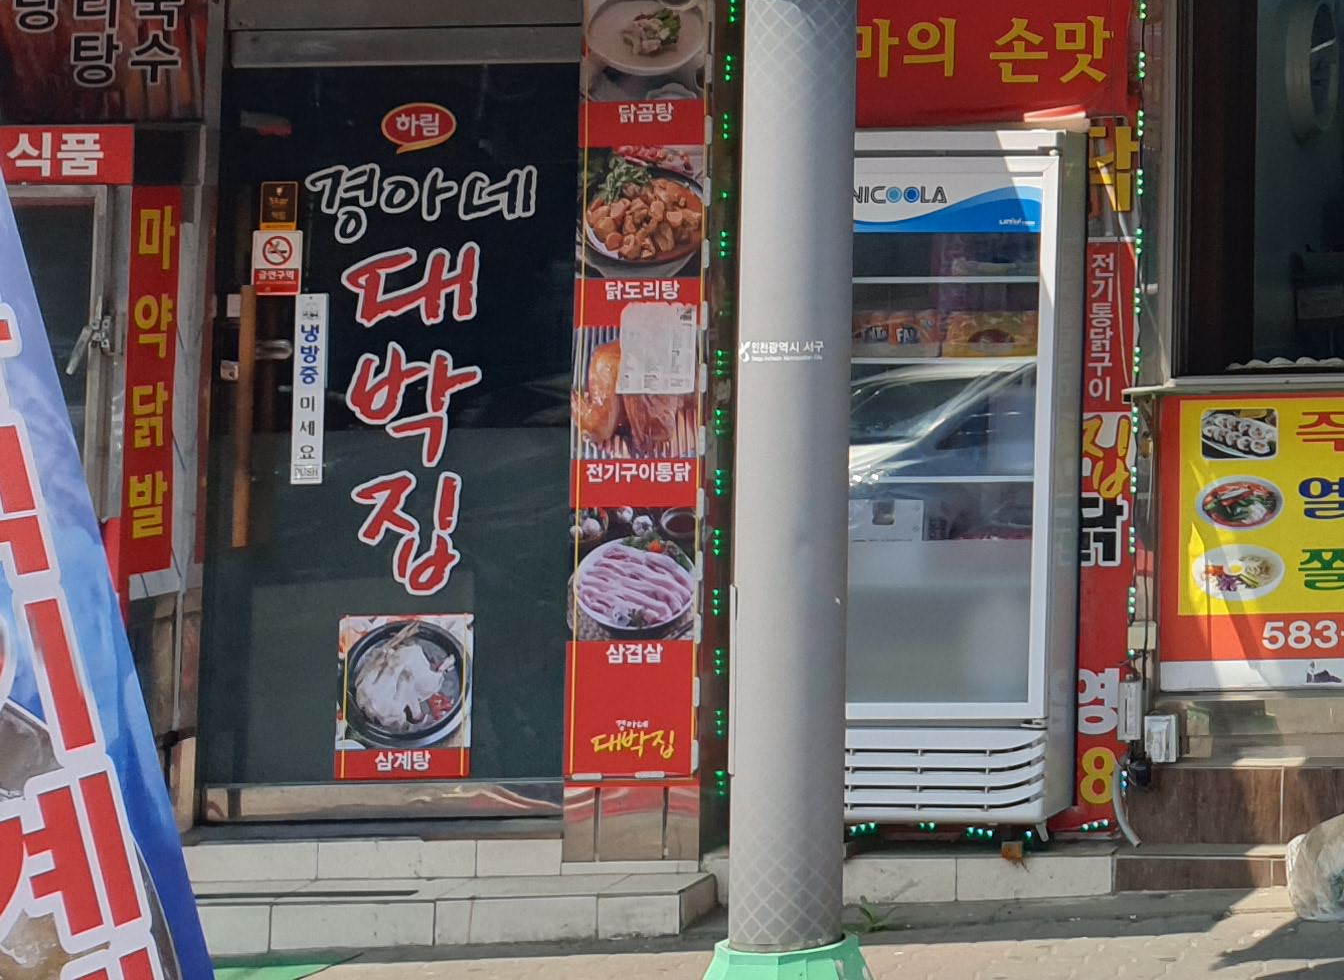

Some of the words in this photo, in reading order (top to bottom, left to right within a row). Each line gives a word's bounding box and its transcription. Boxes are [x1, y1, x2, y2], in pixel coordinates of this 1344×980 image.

[990, 17, 1113, 83] 손맛
[395, 112, 439, 138] 하림
[619, 102, 674, 123] 닭곰탕
[7, 131, 104, 176] 식품
[305, 164, 537, 244] 경아네
[605, 281, 680, 301] 닭도리탕
[1089, 254, 1114, 401] 전기통닭구이
[301, 324, 319, 385] 냉방중
[128, 206, 177, 540] 마약닭발
[340, 241, 481, 594] 대박집
[586, 463, 691, 483] 전기구이통닭
[606, 644, 663, 664] 삼겹살
[374, 749, 431, 772] 삼계탕
[591, 730, 675, 758] 대박집
